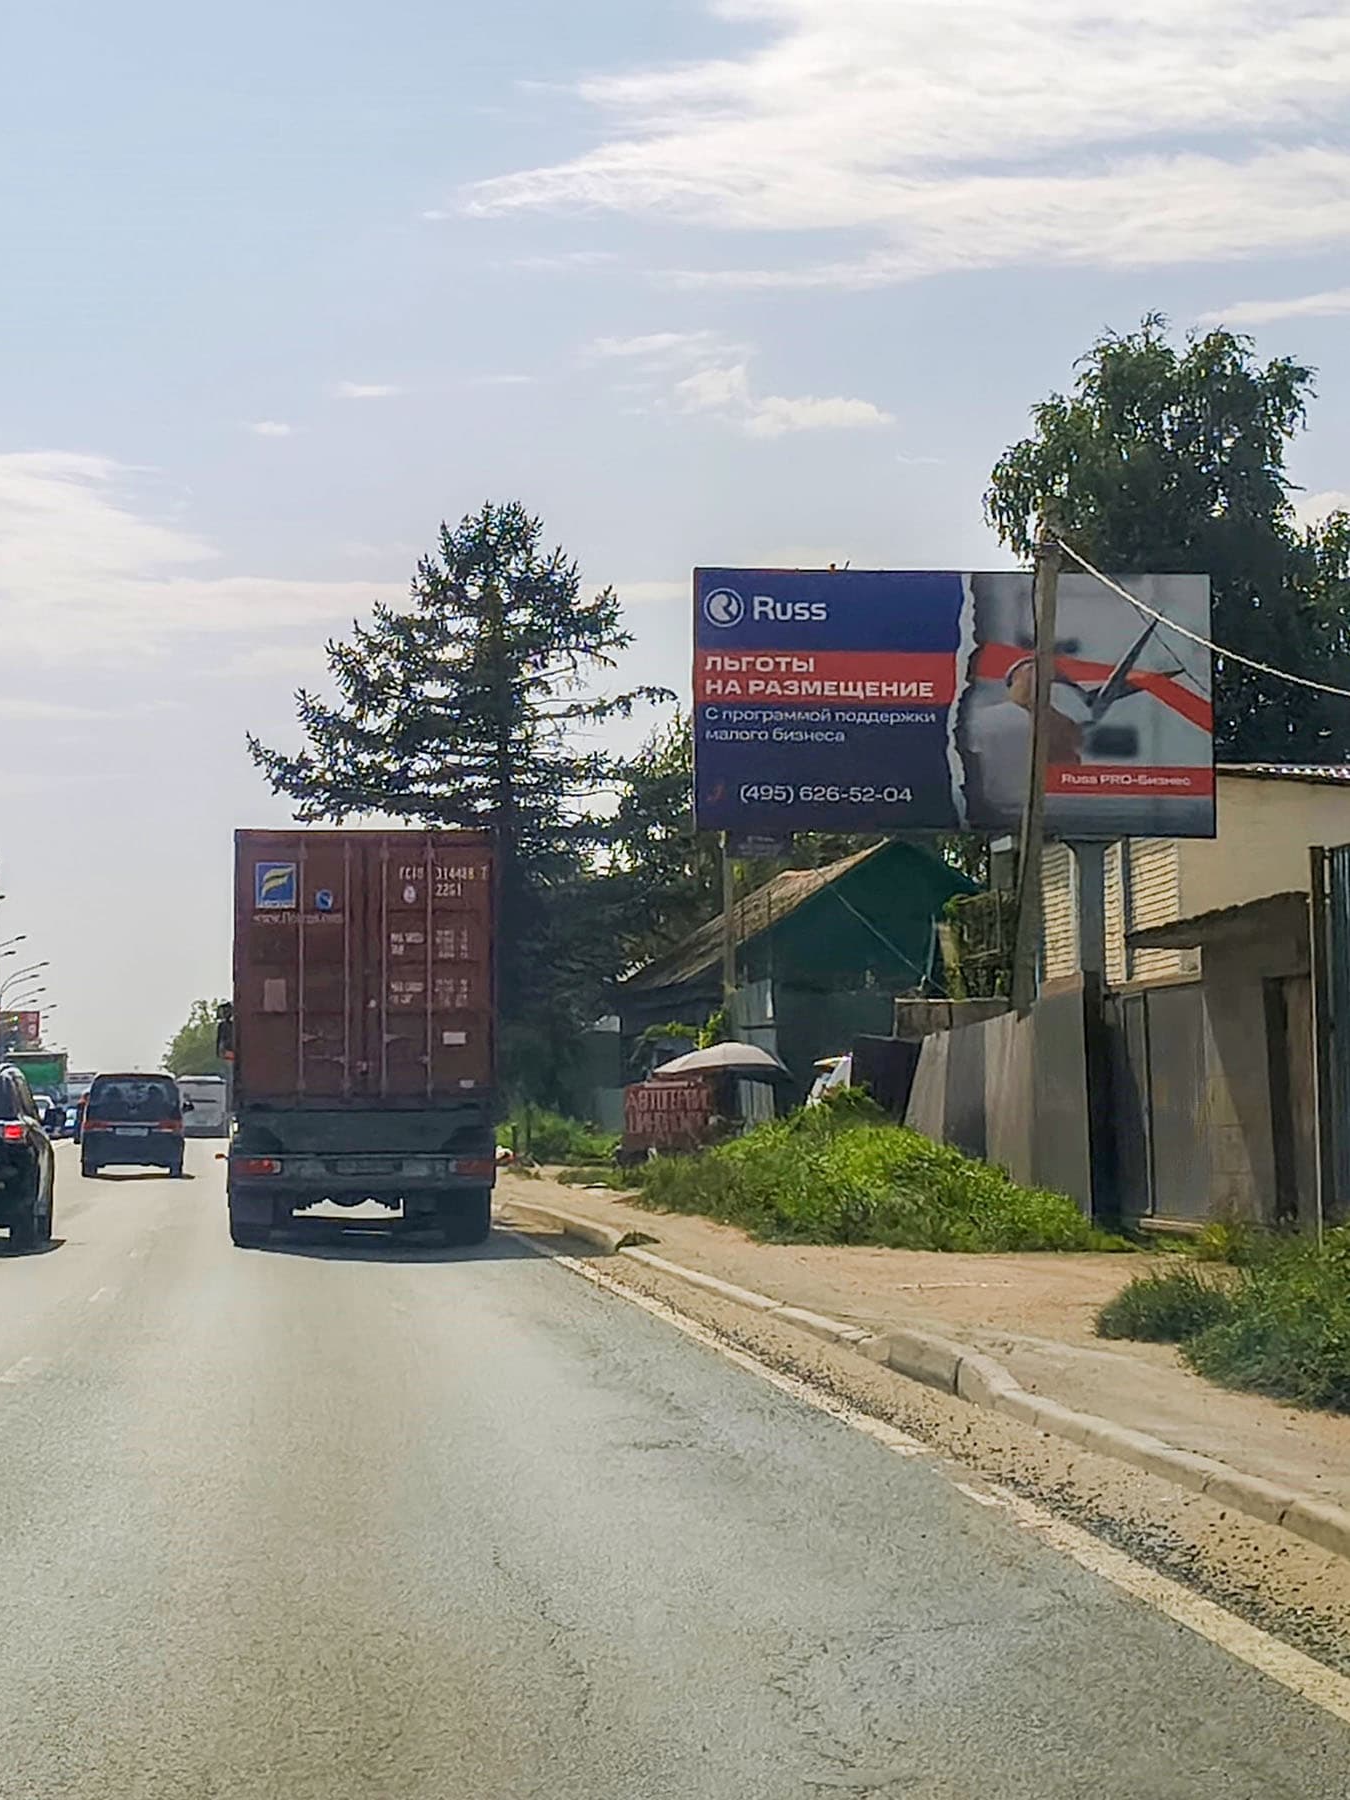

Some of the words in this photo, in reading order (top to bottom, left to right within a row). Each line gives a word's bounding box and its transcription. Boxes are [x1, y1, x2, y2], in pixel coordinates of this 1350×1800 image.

[752, 596, 827, 621] Russ
[705, 656, 815, 673] ЛЬГОТЫ
[705, 679, 742, 695] НА
[749, 680, 934, 700] РАЗМЕЩЕНИЕ
[705, 707, 719, 721] С
[722, 708, 832, 724] программой
[835, 710, 937, 726] поддержки
[705, 729, 769, 742] малого
[772, 727, 846, 743] бизнеса
[1061, 773, 1098, 785] Russ
[739, 784, 794, 804] (495)
[799, 786, 913, 803] 626-52-04
